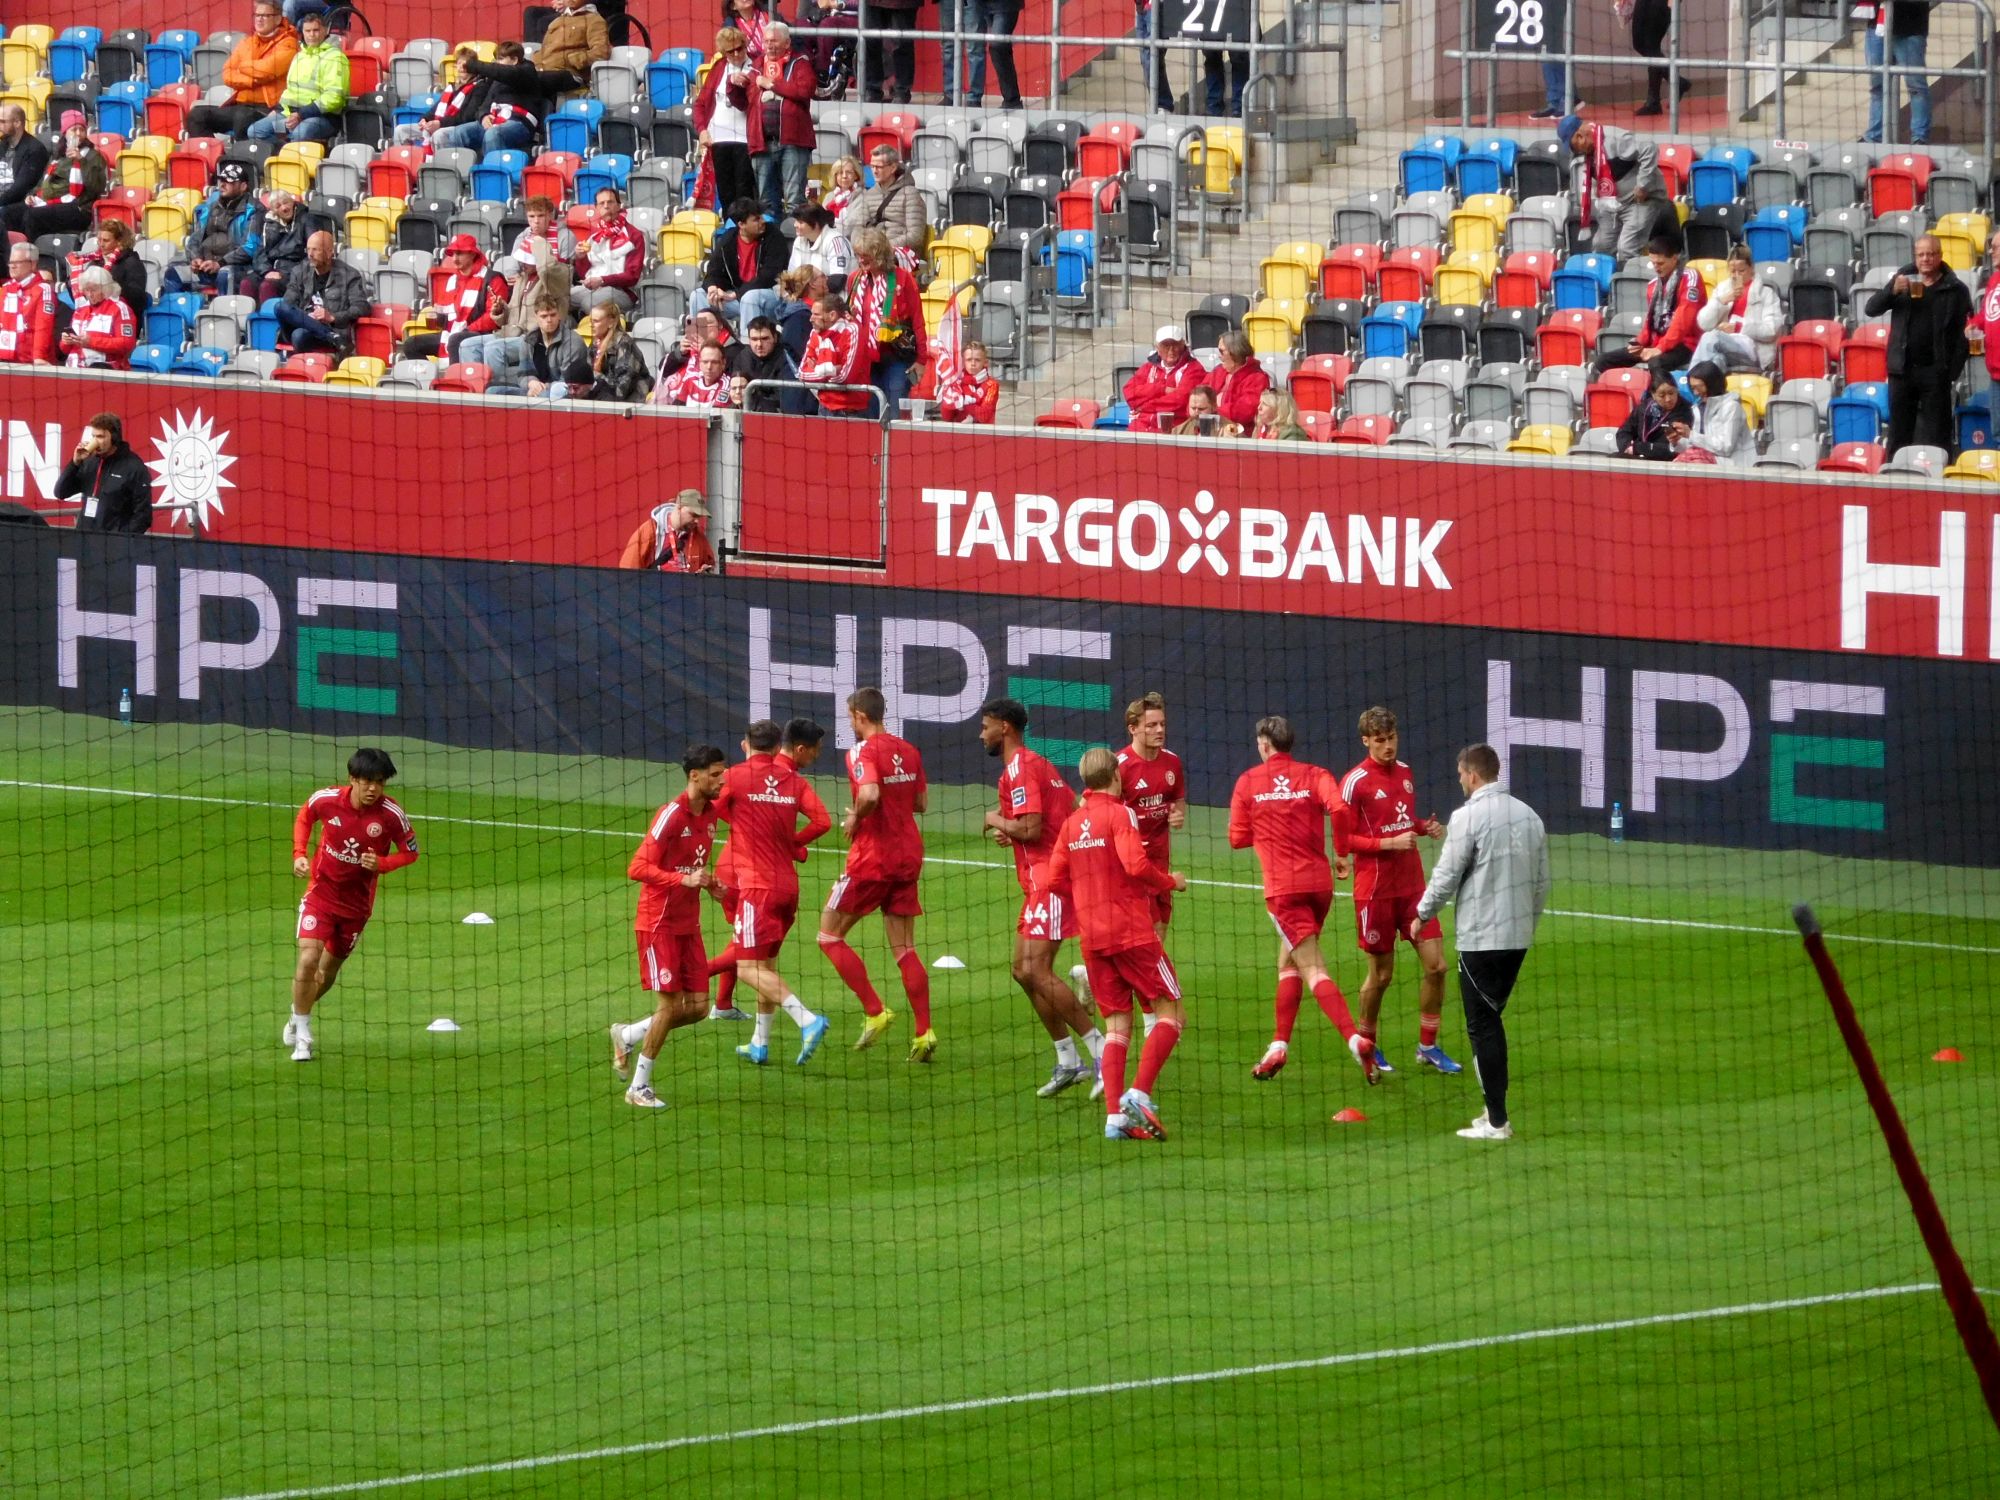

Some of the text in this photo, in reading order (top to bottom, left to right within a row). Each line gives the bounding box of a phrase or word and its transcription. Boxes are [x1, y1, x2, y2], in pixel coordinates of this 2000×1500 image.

[1182, 0, 1226, 32] 27
[1495, 0, 1544, 45] 28
[57, 557, 398, 716] HPE
[748, 606, 1112, 768] HPE
[1253, 789, 1311, 803] TARGOBANK
[1486, 659, 1886, 831] HPE
